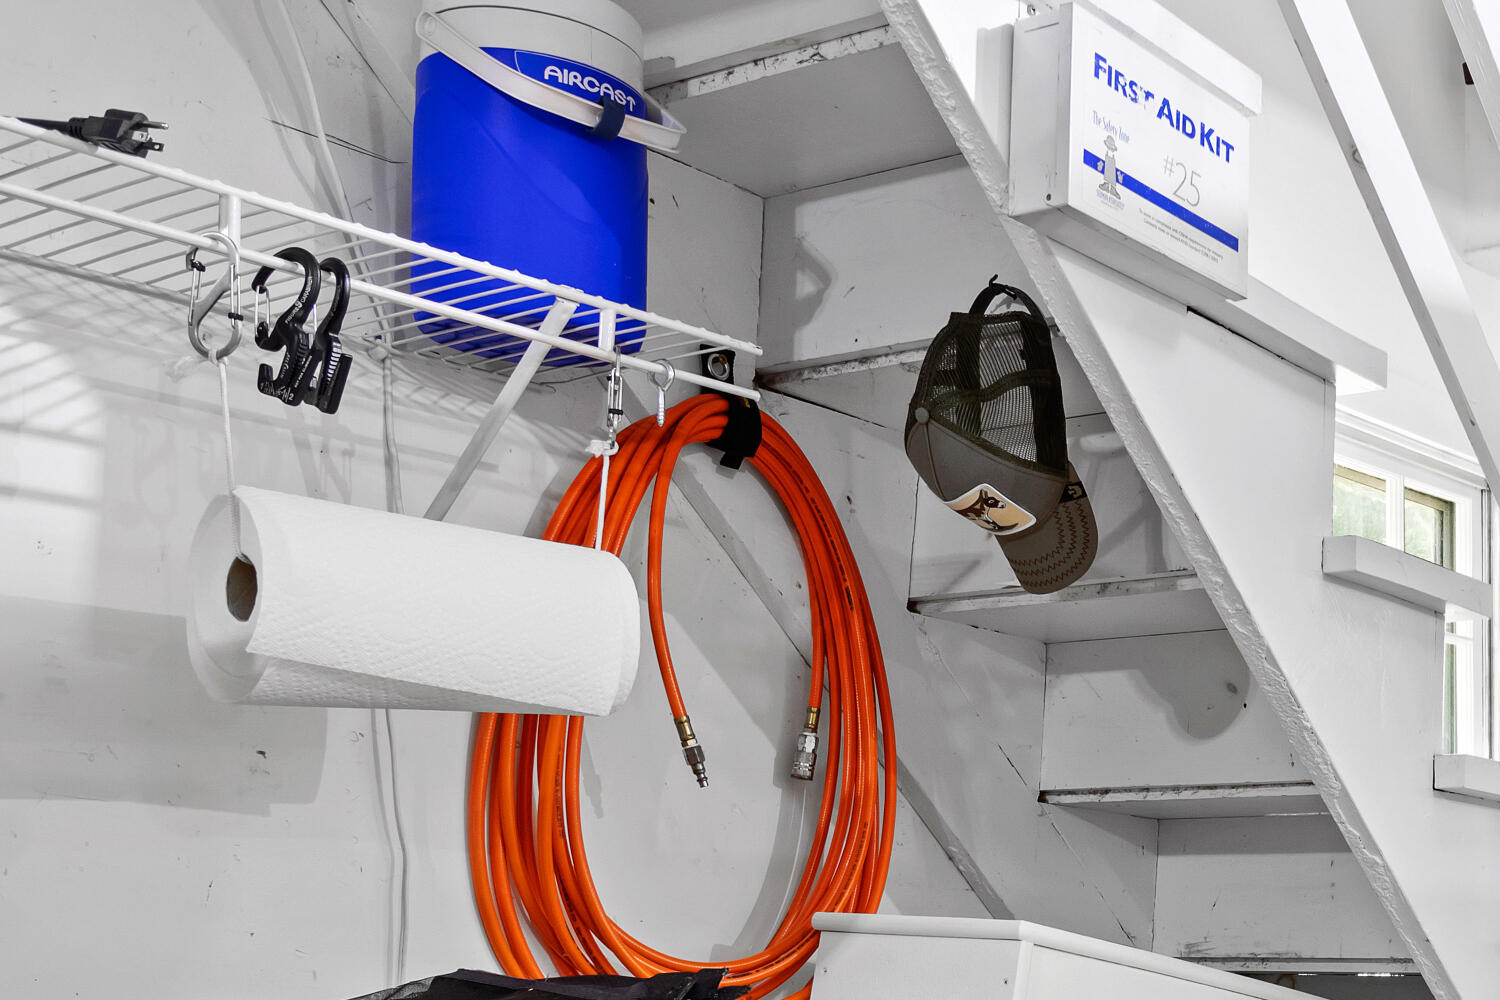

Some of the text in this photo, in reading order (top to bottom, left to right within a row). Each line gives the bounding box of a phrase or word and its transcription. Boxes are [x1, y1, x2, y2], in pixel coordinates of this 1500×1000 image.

[544, 65, 636, 112] AIRCAST
[1157, 97, 1196, 139] AID
[1200, 121, 1235, 163] KIT
[1163, 155, 1202, 207] #25
